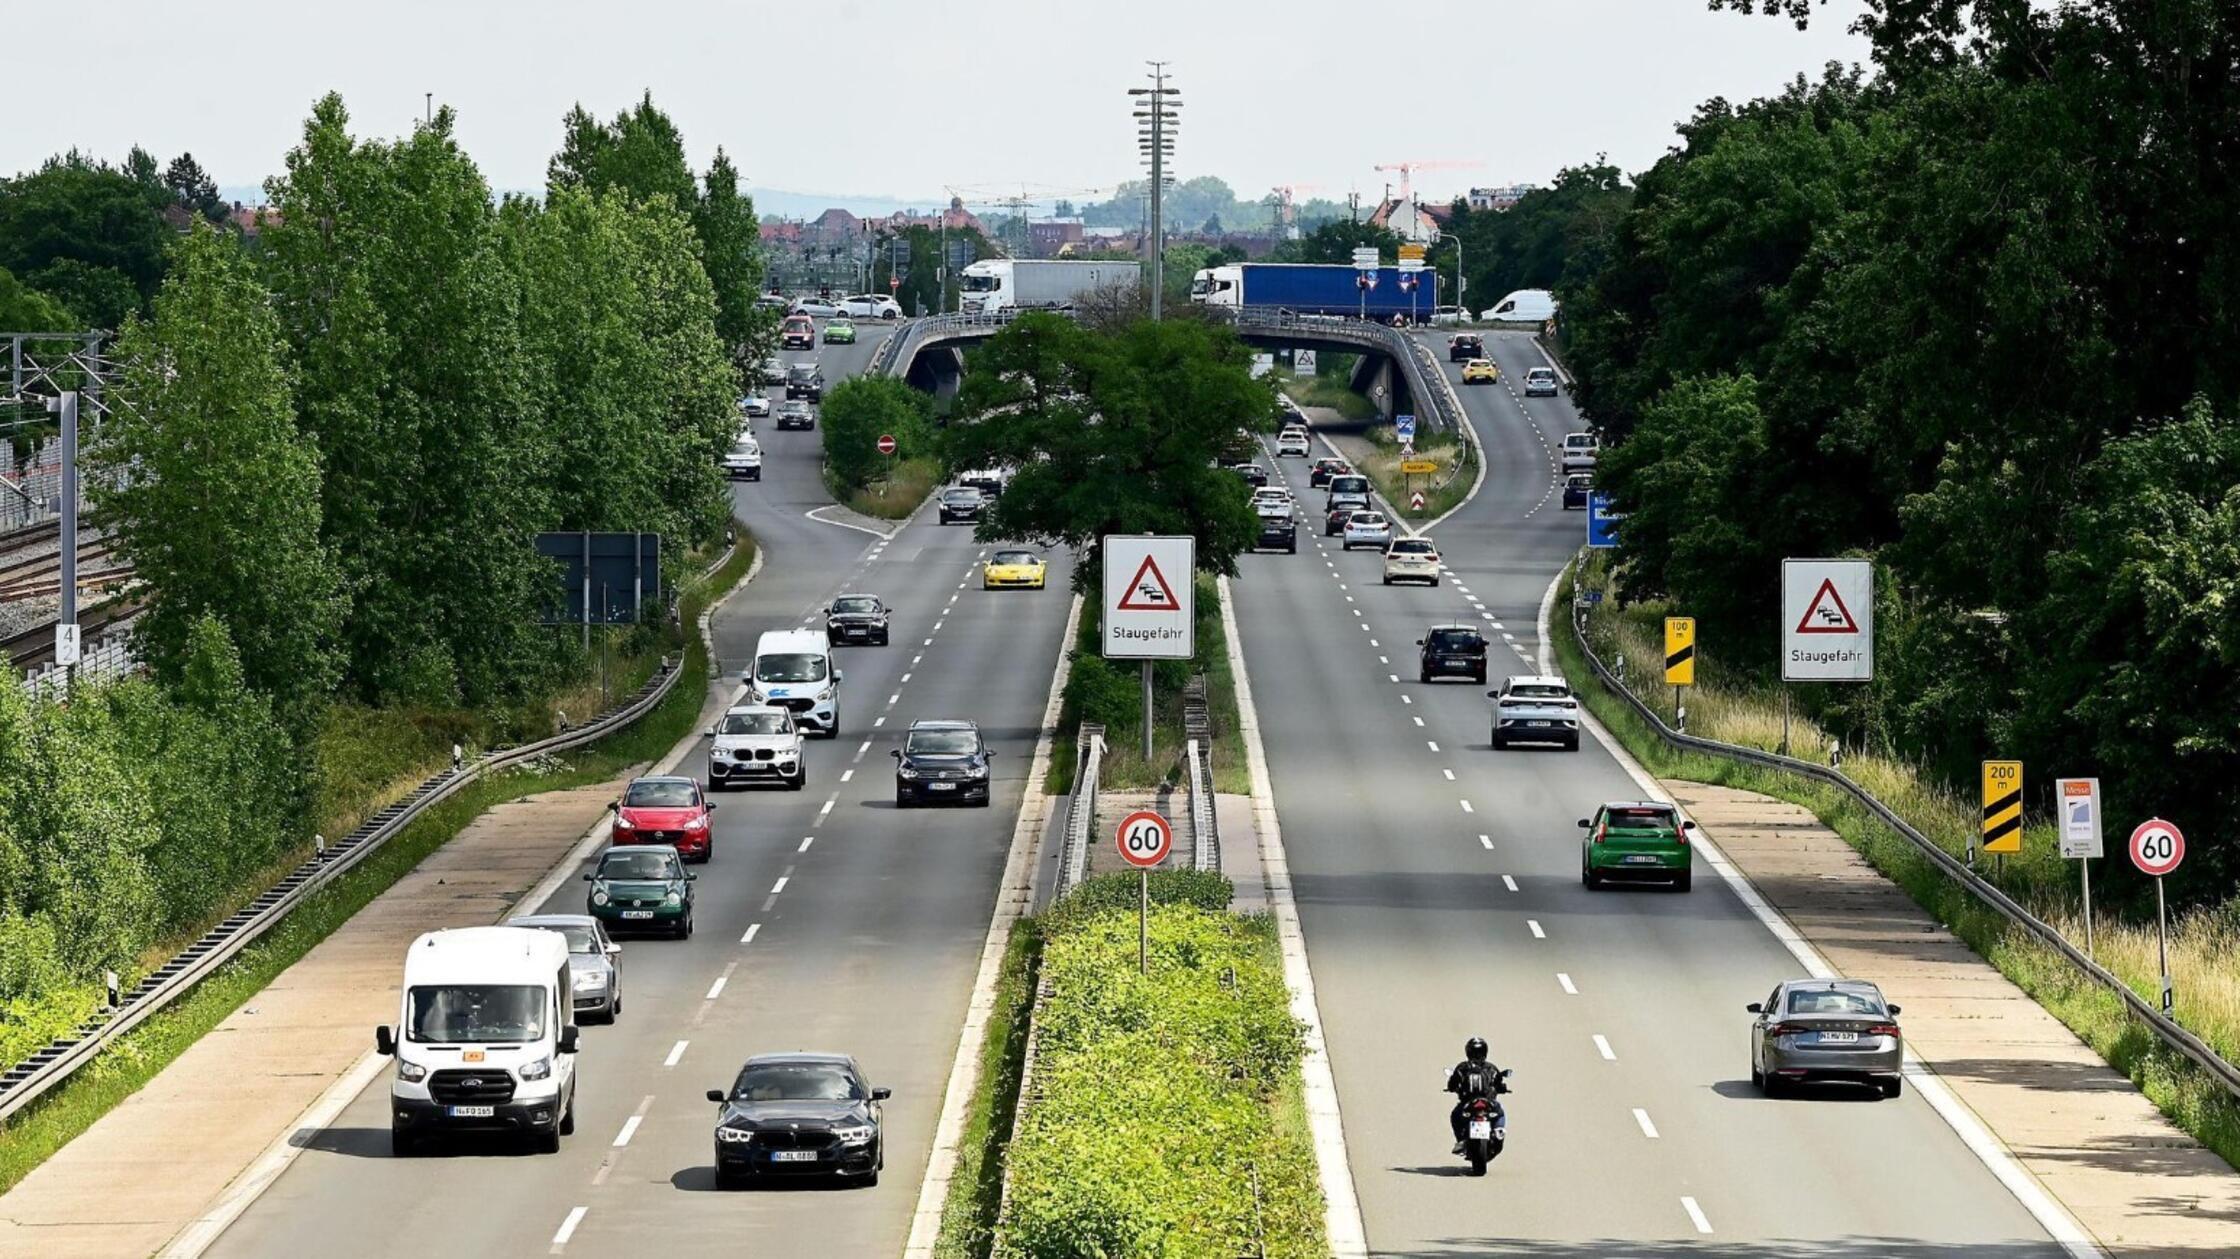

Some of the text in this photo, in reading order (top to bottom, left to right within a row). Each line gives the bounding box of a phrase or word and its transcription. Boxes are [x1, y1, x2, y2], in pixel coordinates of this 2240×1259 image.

[1112, 626, 1184, 641] Staugefahr
[1672, 621, 1688, 631] 100
[63, 626, 73, 643] 4
[1791, 649, 1863, 664] Staugefahr
[1990, 766, 2015, 779] 200
[1997, 781, 2008, 790] m
[1129, 826, 1160, 851] 60
[2142, 835, 2173, 860] 60
